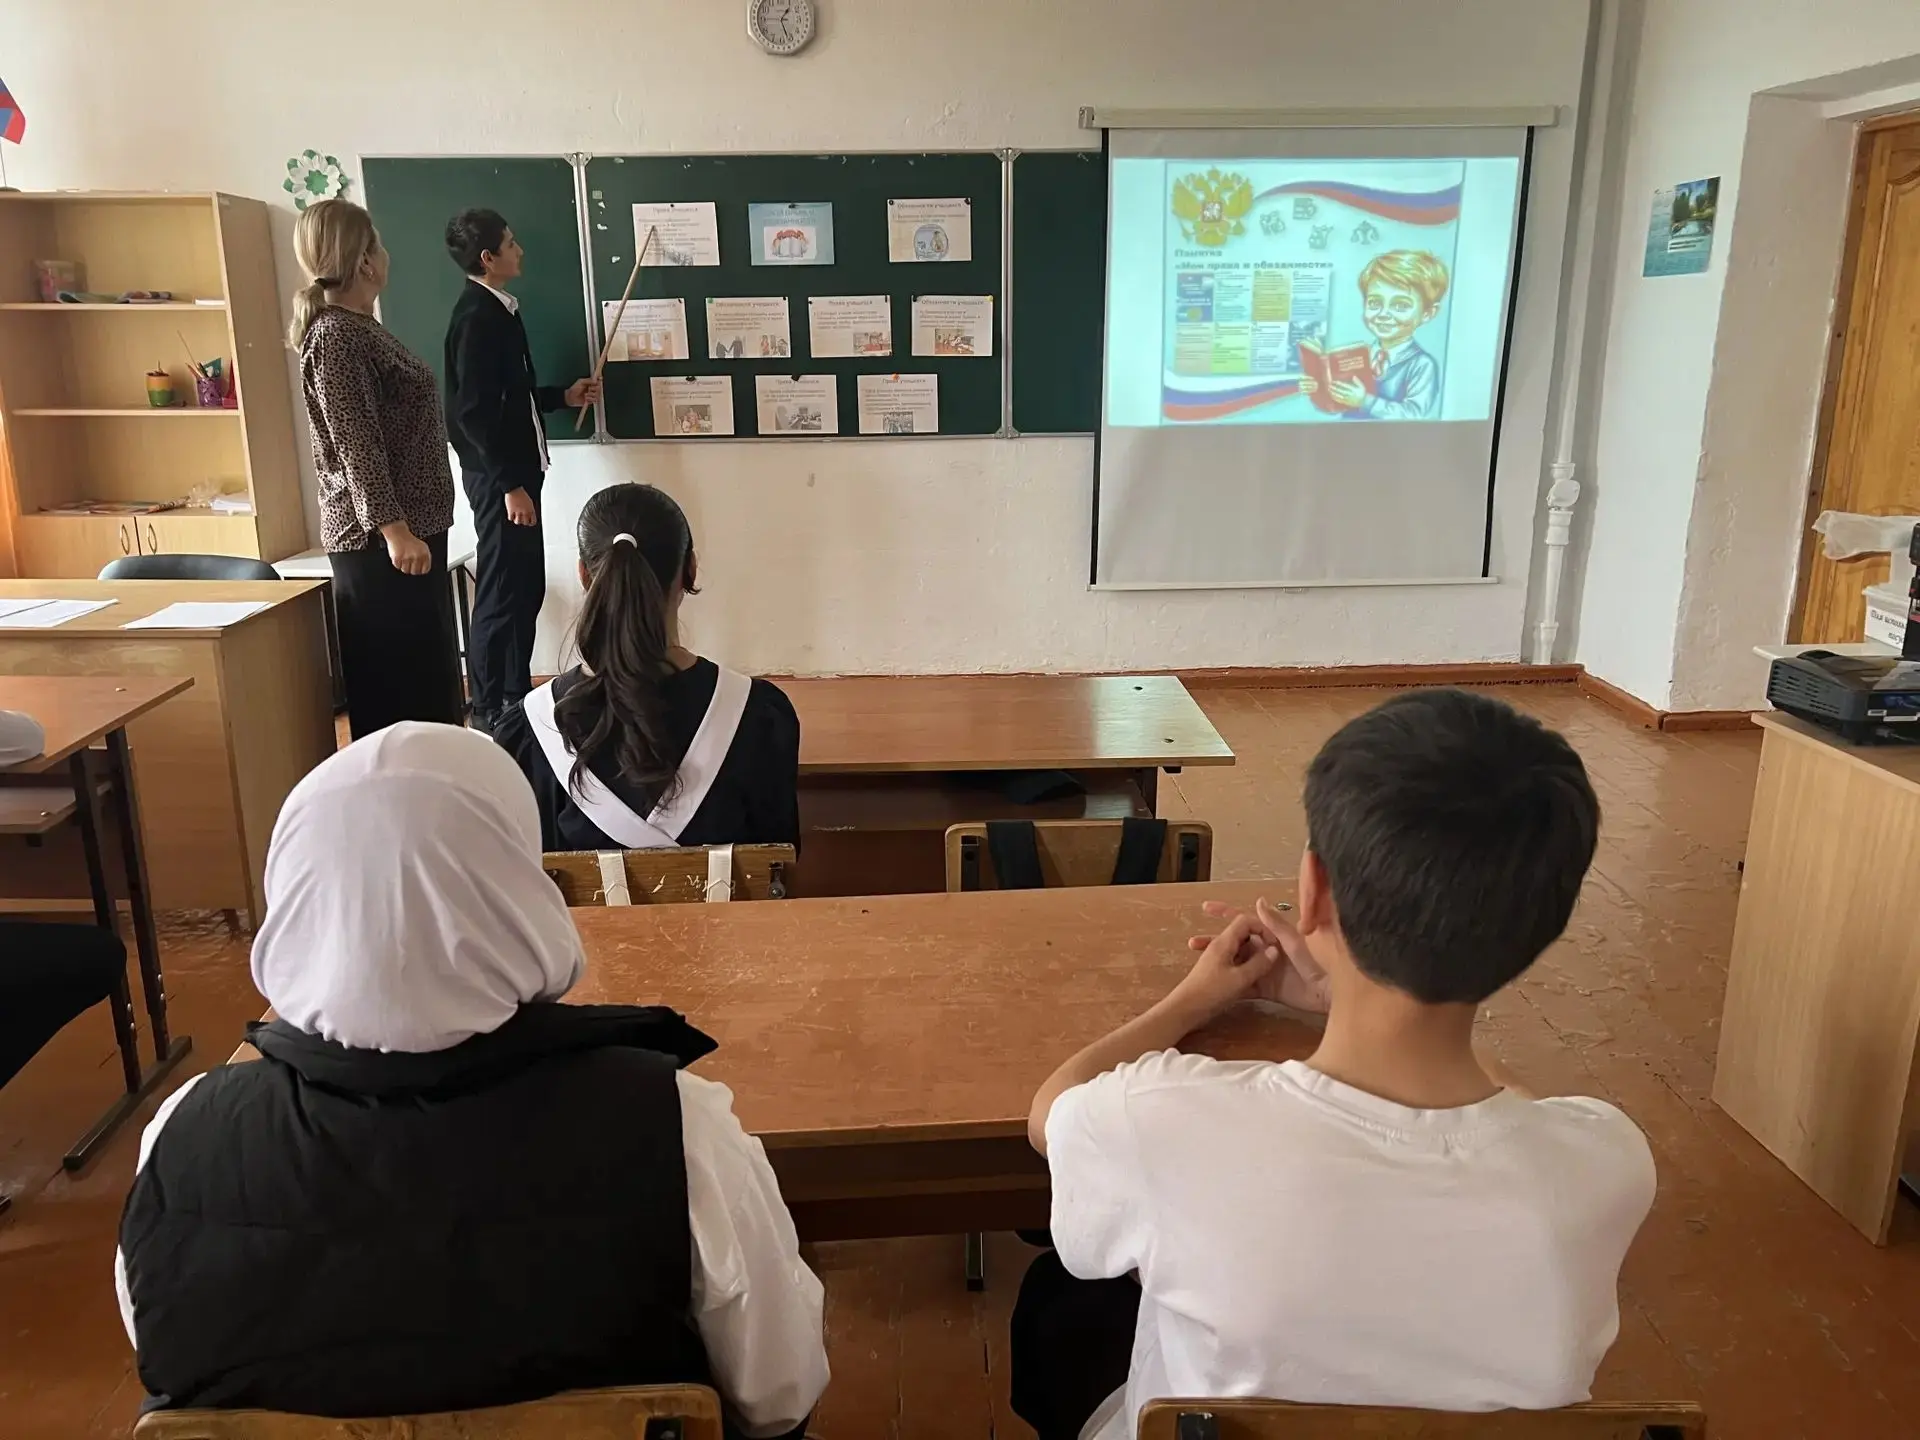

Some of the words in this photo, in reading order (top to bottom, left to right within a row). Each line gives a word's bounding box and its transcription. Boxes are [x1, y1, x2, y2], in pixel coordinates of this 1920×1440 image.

[1174, 248, 1222, 257] Памятка
[1207, 262, 1240, 271] права
[1254, 260, 1334, 269] обязанности»
